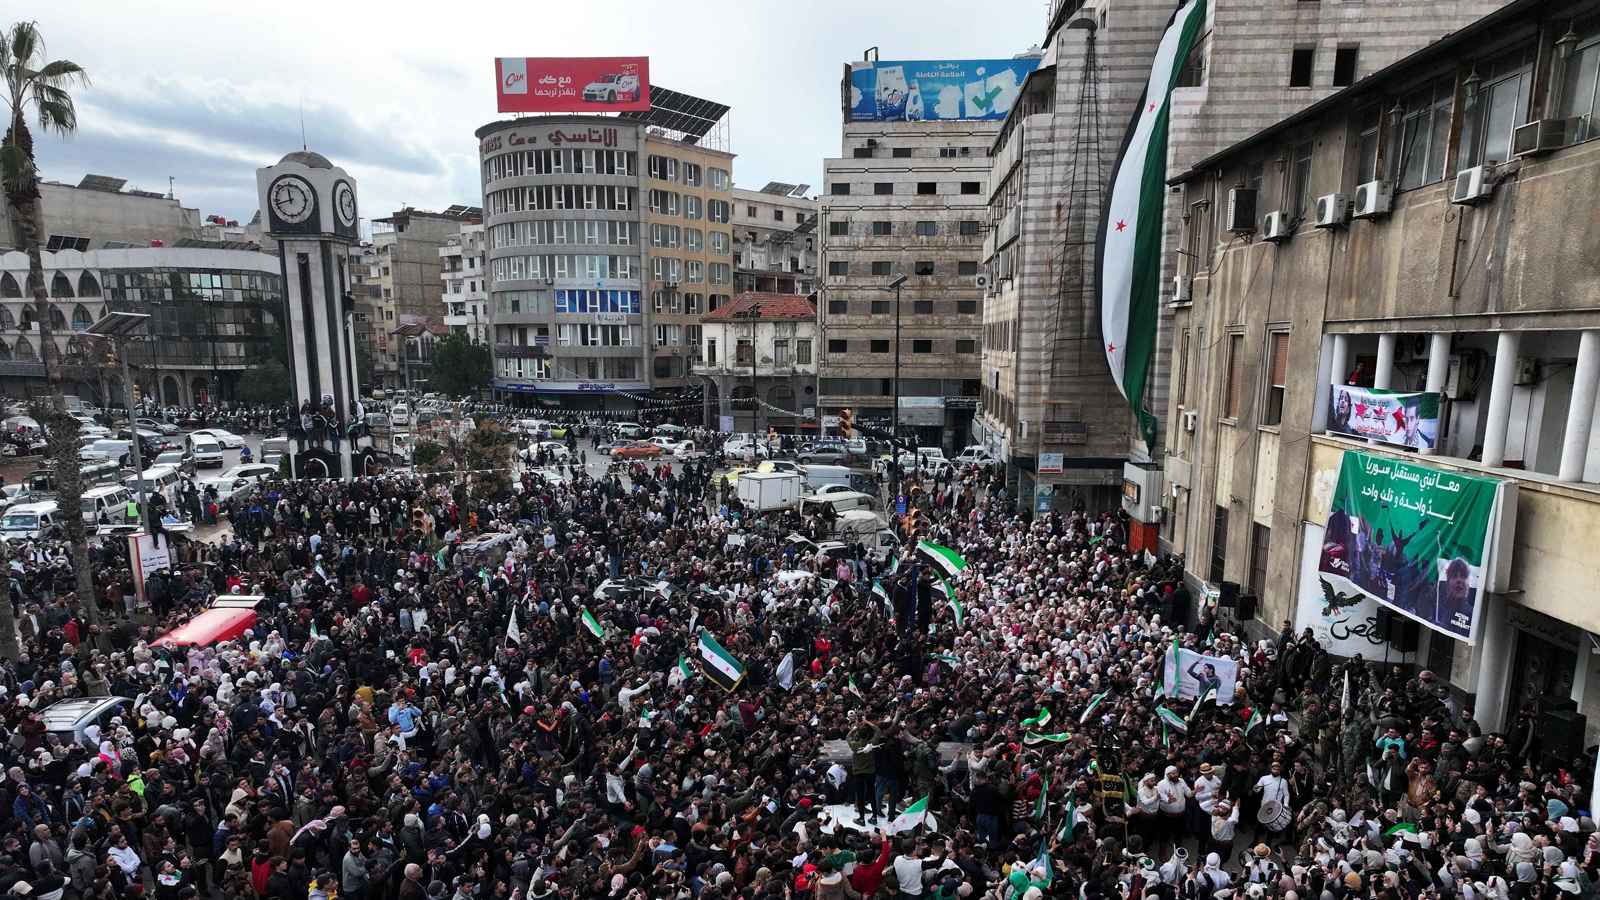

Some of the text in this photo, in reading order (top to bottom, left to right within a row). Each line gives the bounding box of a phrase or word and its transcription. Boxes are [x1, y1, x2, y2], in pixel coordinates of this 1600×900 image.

[1366, 456, 1391, 476] سوريا
[1390, 463, 1420, 481] مستقبل
[1420, 472, 1436, 491] نبني
[1361, 483, 1379, 502] واحد
[1399, 492, 1426, 517] واحدة
